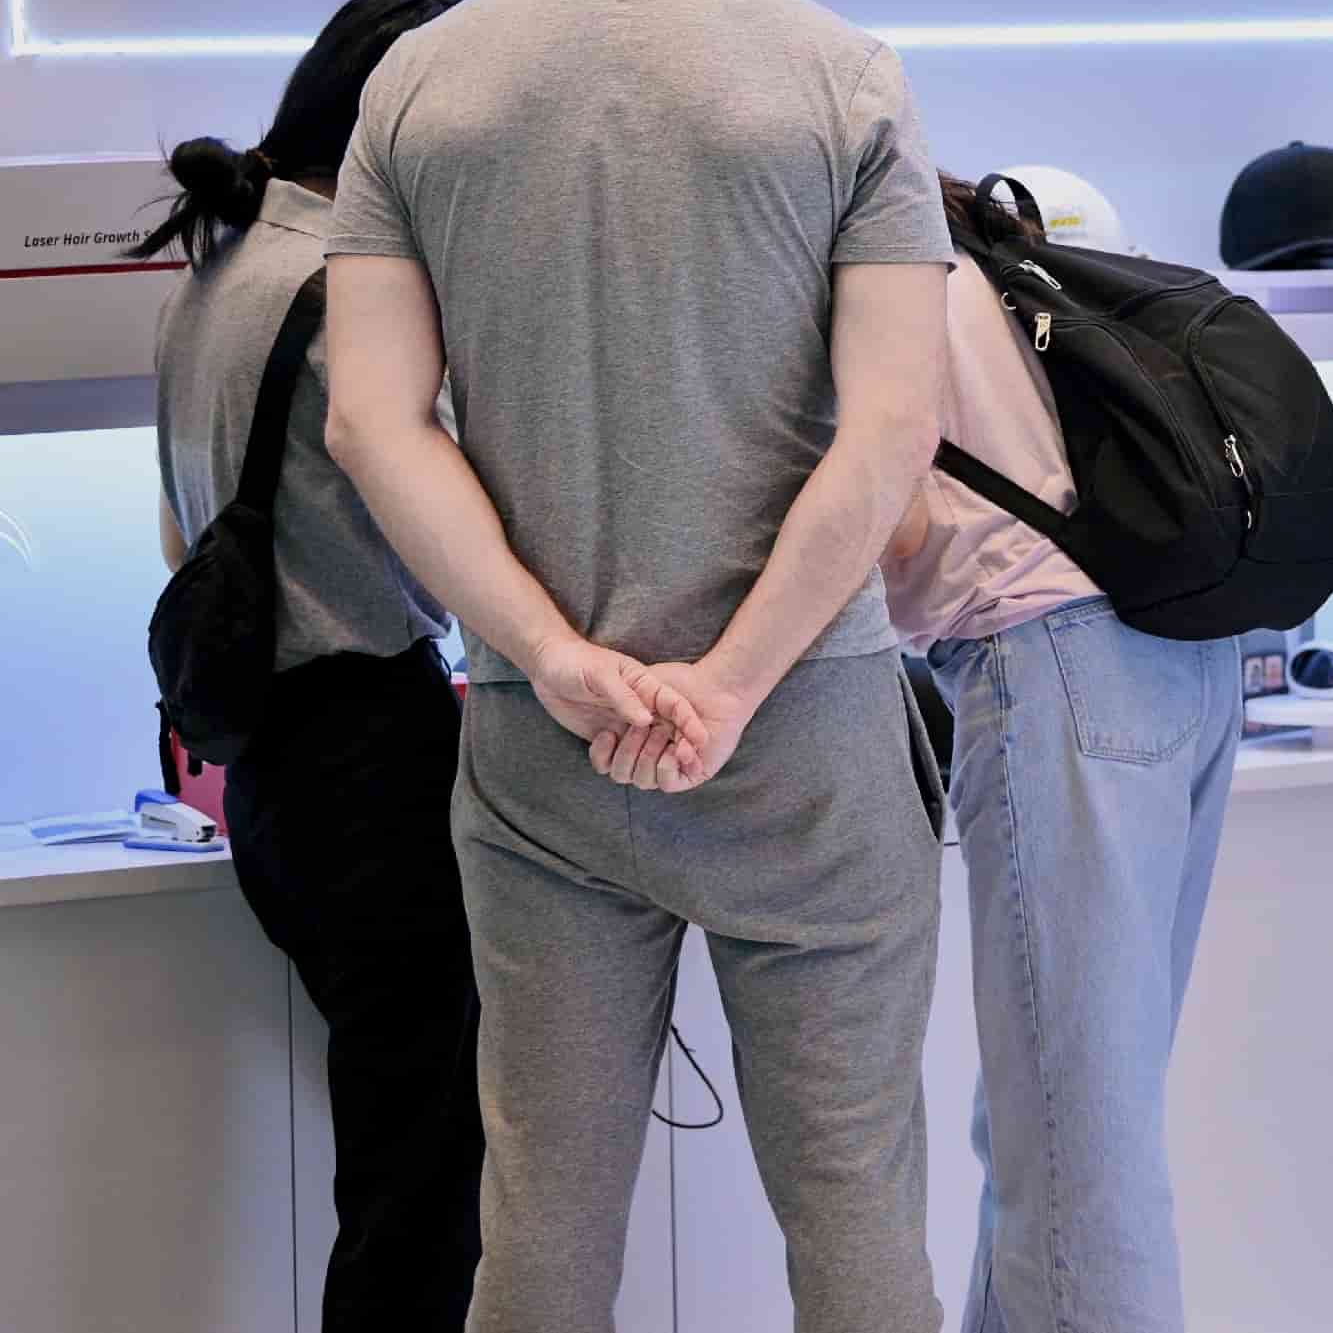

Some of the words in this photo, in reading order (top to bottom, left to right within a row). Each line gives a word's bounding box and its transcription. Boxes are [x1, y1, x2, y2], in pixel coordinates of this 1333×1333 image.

[24, 235, 60, 248] Laser
[63, 233, 90, 246] Hair
[94, 230, 140, 245] Growth
